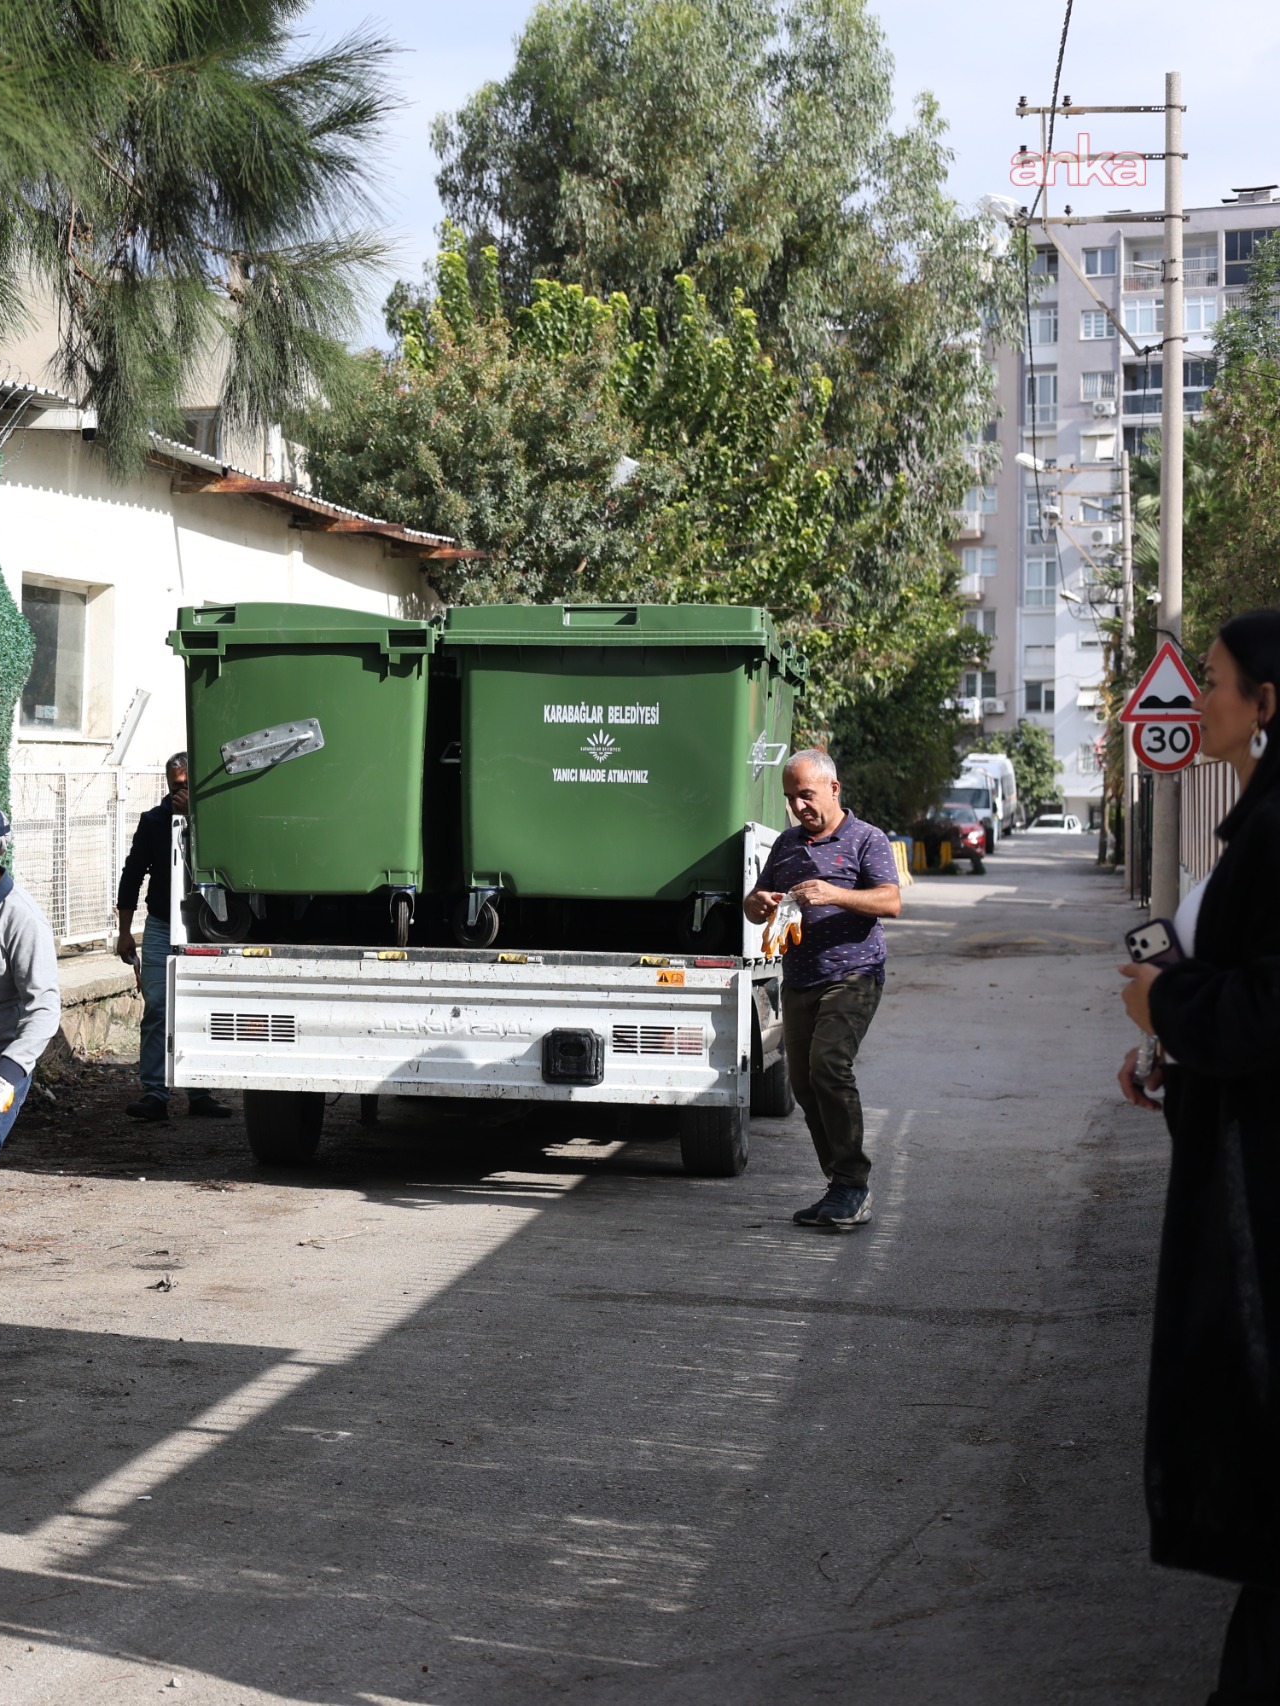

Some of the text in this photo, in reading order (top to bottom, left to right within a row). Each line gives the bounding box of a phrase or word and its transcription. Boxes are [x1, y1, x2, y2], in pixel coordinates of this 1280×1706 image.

[544, 701, 660, 725] KARABAĞLAR BELEDİYESİ
[1146, 726, 1191, 754] 30
[552, 768, 648, 784] YANICI MADDE ATMAYINIZ
